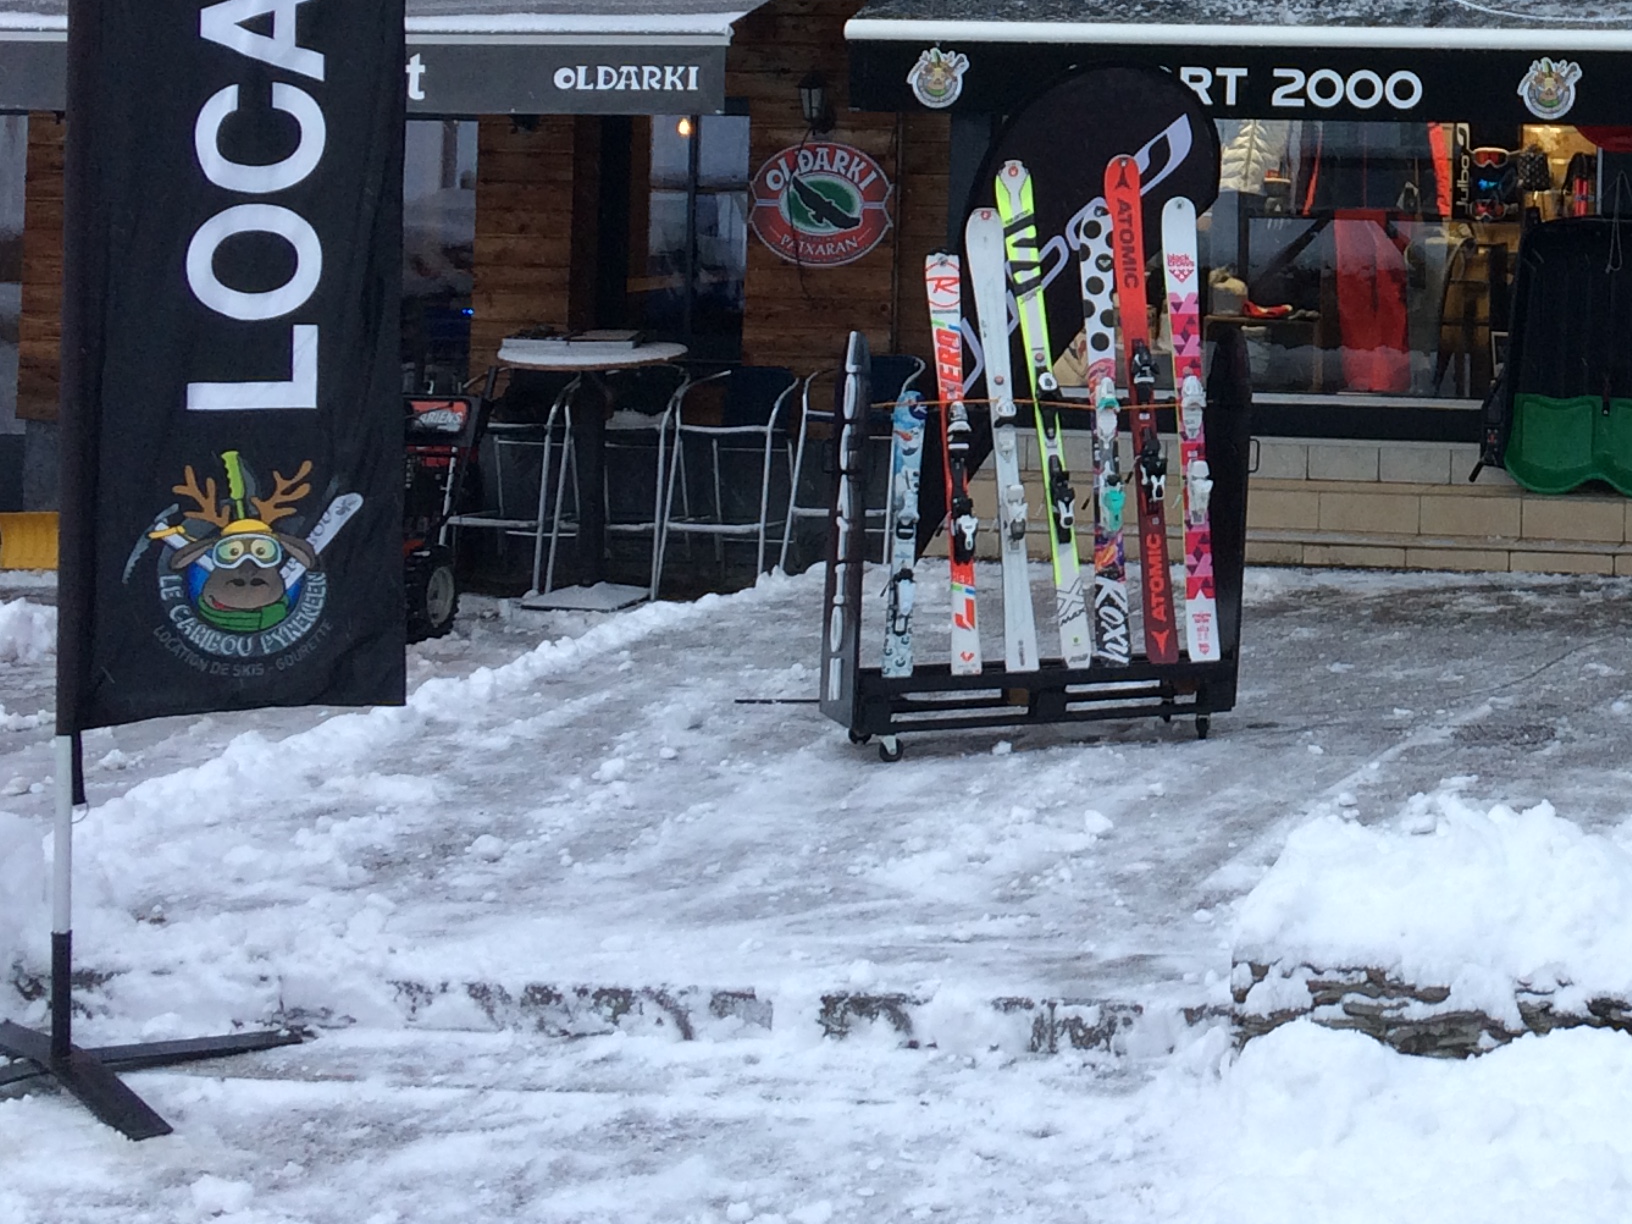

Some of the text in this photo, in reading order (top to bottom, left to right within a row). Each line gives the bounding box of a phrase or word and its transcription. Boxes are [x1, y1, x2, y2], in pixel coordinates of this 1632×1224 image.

[1271, 68, 1423, 109] 2000
[1117, 197, 1140, 289] ATOMIC
[159, 575, 183, 601] LE
[1146, 533, 1167, 622] ATOMIC
